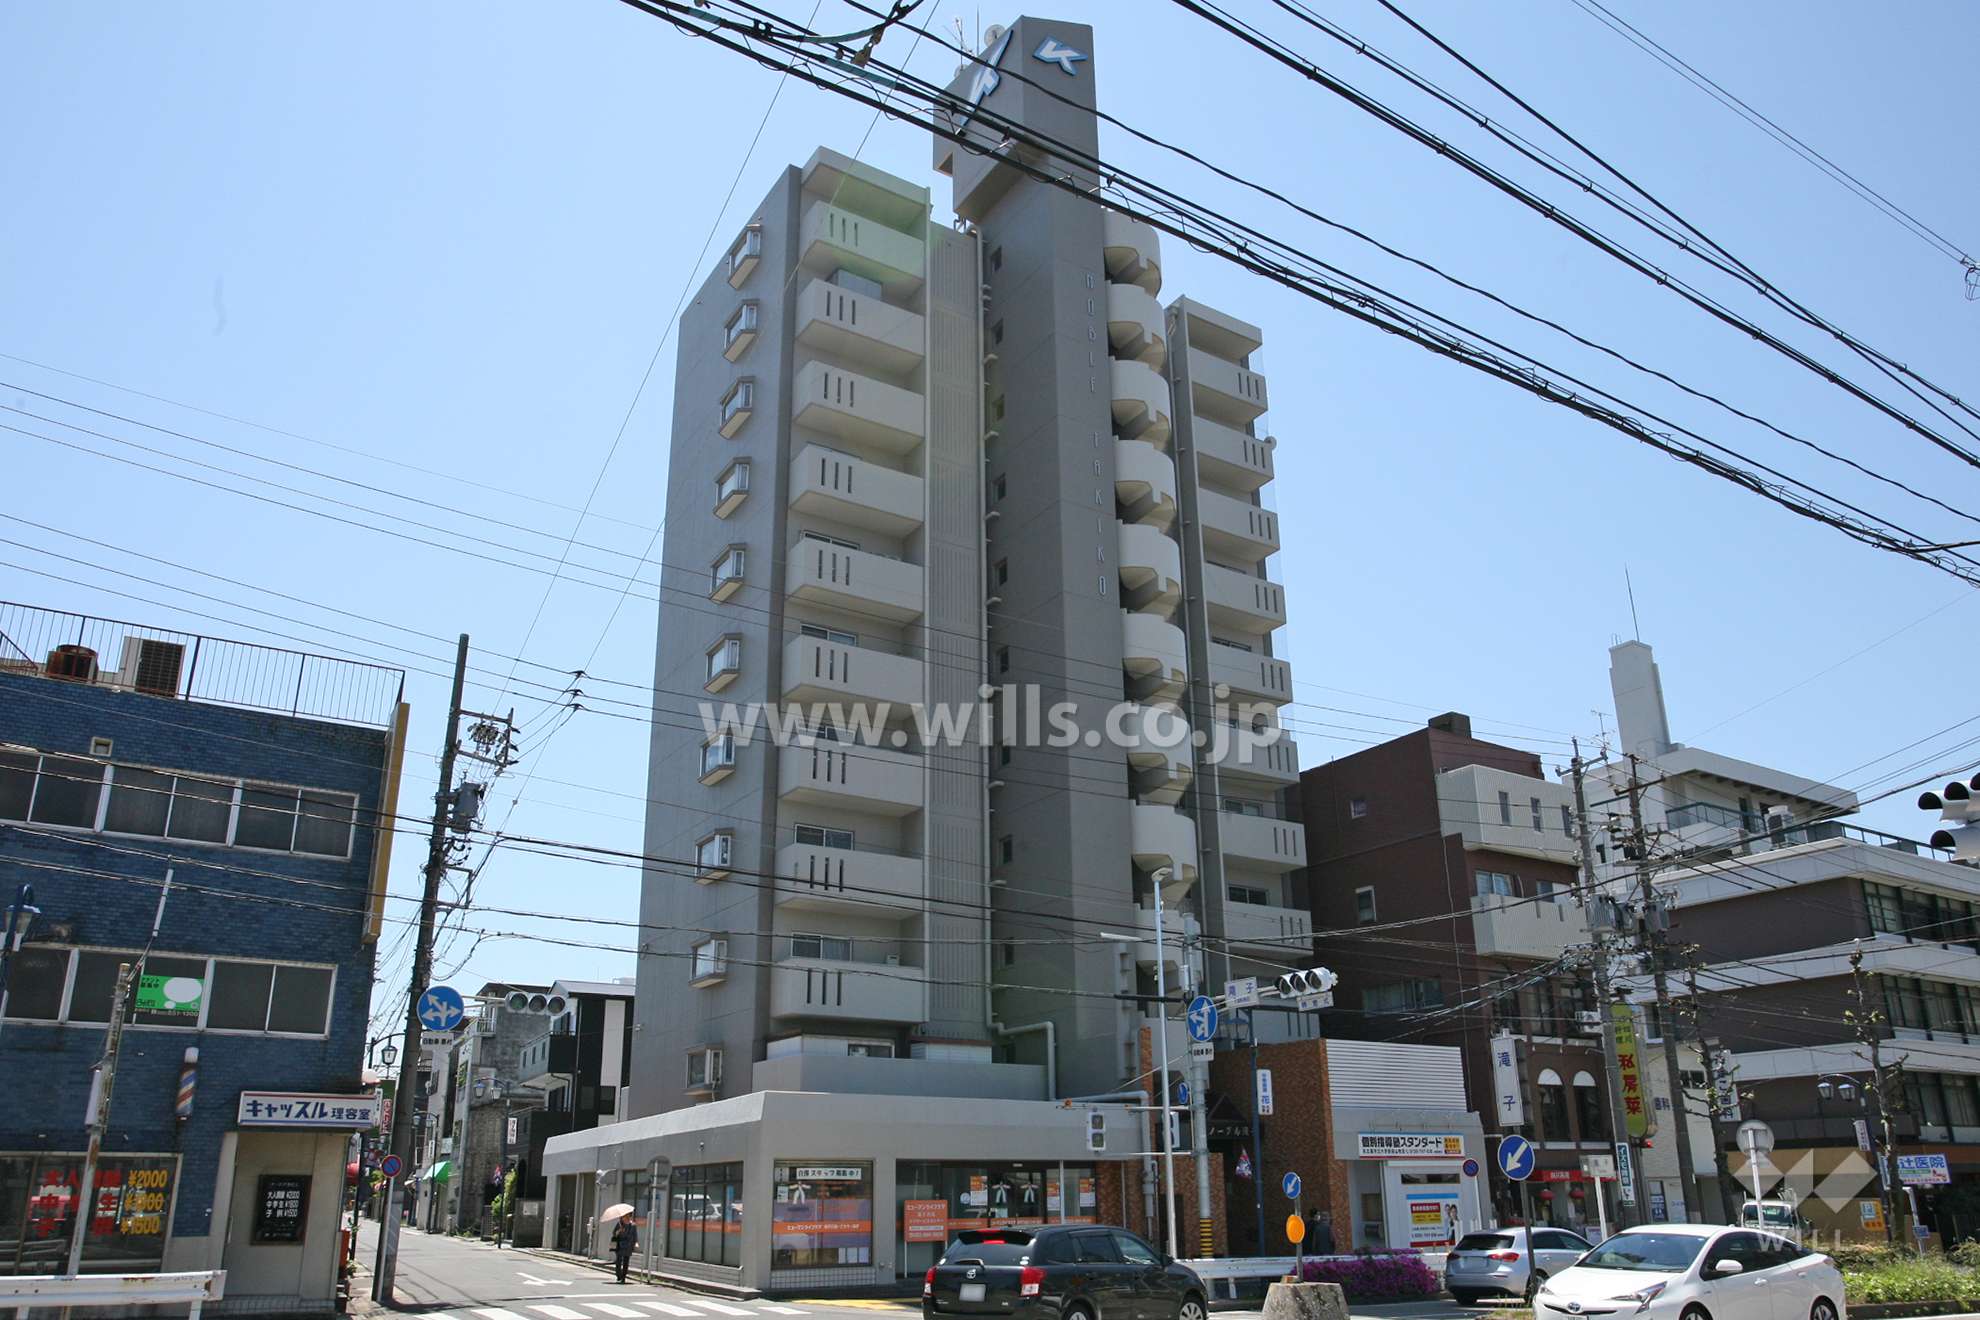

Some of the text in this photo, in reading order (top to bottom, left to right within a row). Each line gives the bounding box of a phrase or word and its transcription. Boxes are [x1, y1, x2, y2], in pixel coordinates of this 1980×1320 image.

[1497, 1051, 1516, 1111] 滝子
[246, 1100, 328, 1119] キャッスル
[331, 1108, 371, 1120] 理容室
[1900, 1156, 1945, 1169] 辻医院
[128, 1170, 168, 1187] ¥2000
[119, 1216, 161, 1234] ¥1500
